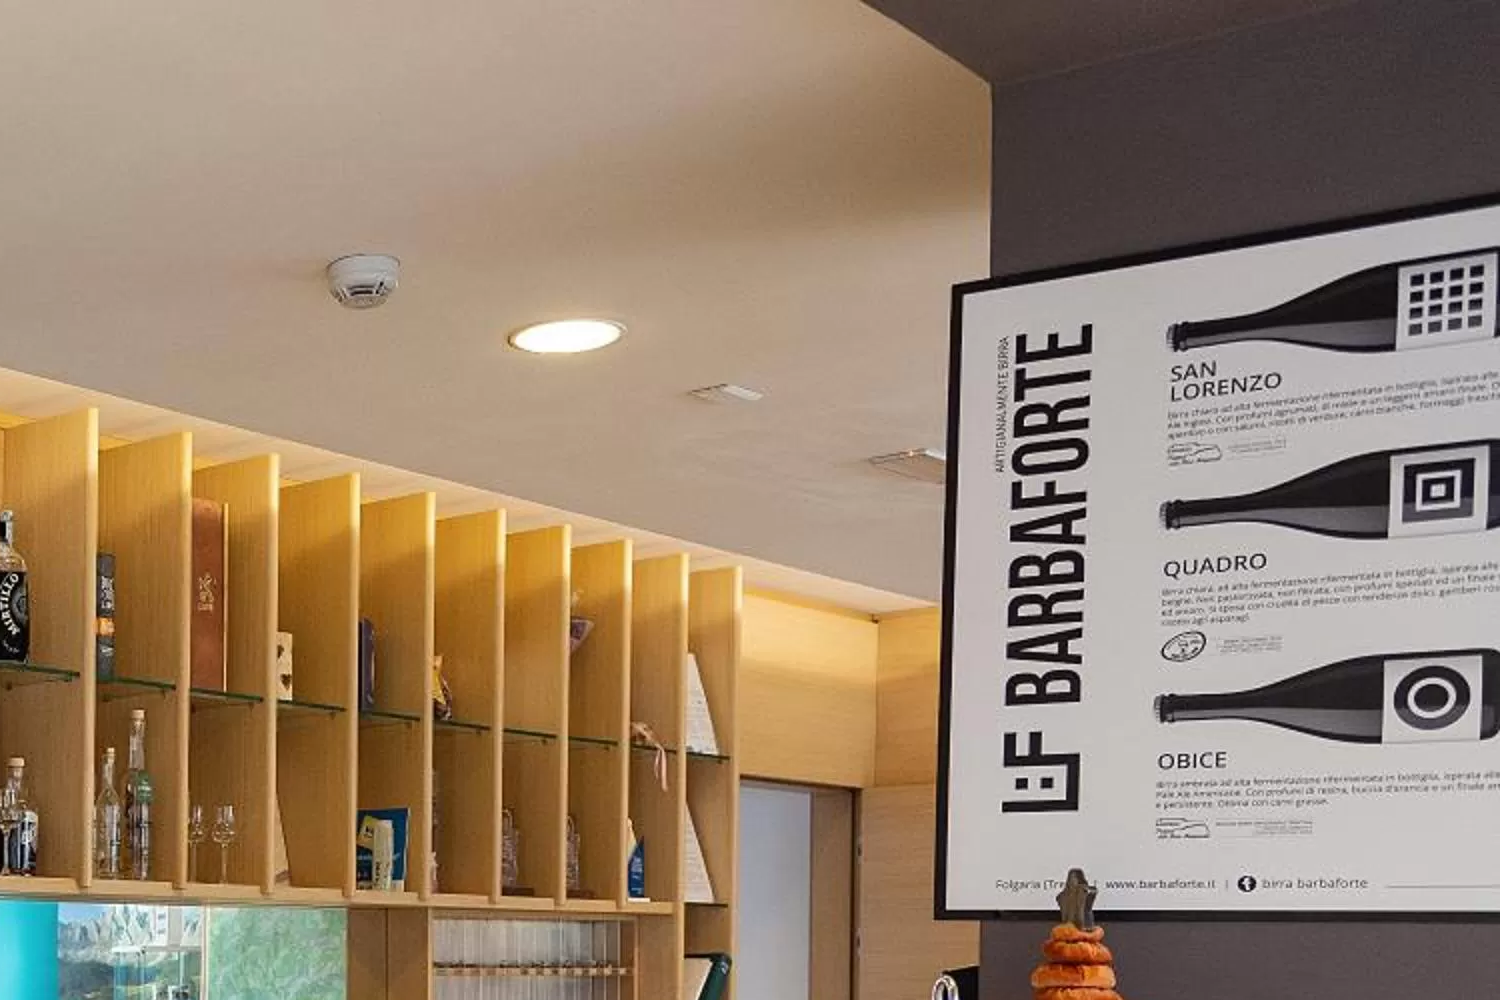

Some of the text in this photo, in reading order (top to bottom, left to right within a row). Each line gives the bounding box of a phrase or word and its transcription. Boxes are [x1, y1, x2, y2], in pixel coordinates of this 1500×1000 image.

[1171, 360, 1216, 383] SAN
[1171, 372, 1282, 402] LORENZO
[1005, 324, 1093, 706] BARBAFORTE
[1164, 553, 1267, 580] QUADRO
[1158, 752, 1227, 770] OBICE
[995, 879, 1041, 892] Folgaria
[1105, 879, 1216, 890] www.barbaforte.it
[1262, 878, 1293, 889] birra
[1297, 878, 1368, 889] barbaforte
